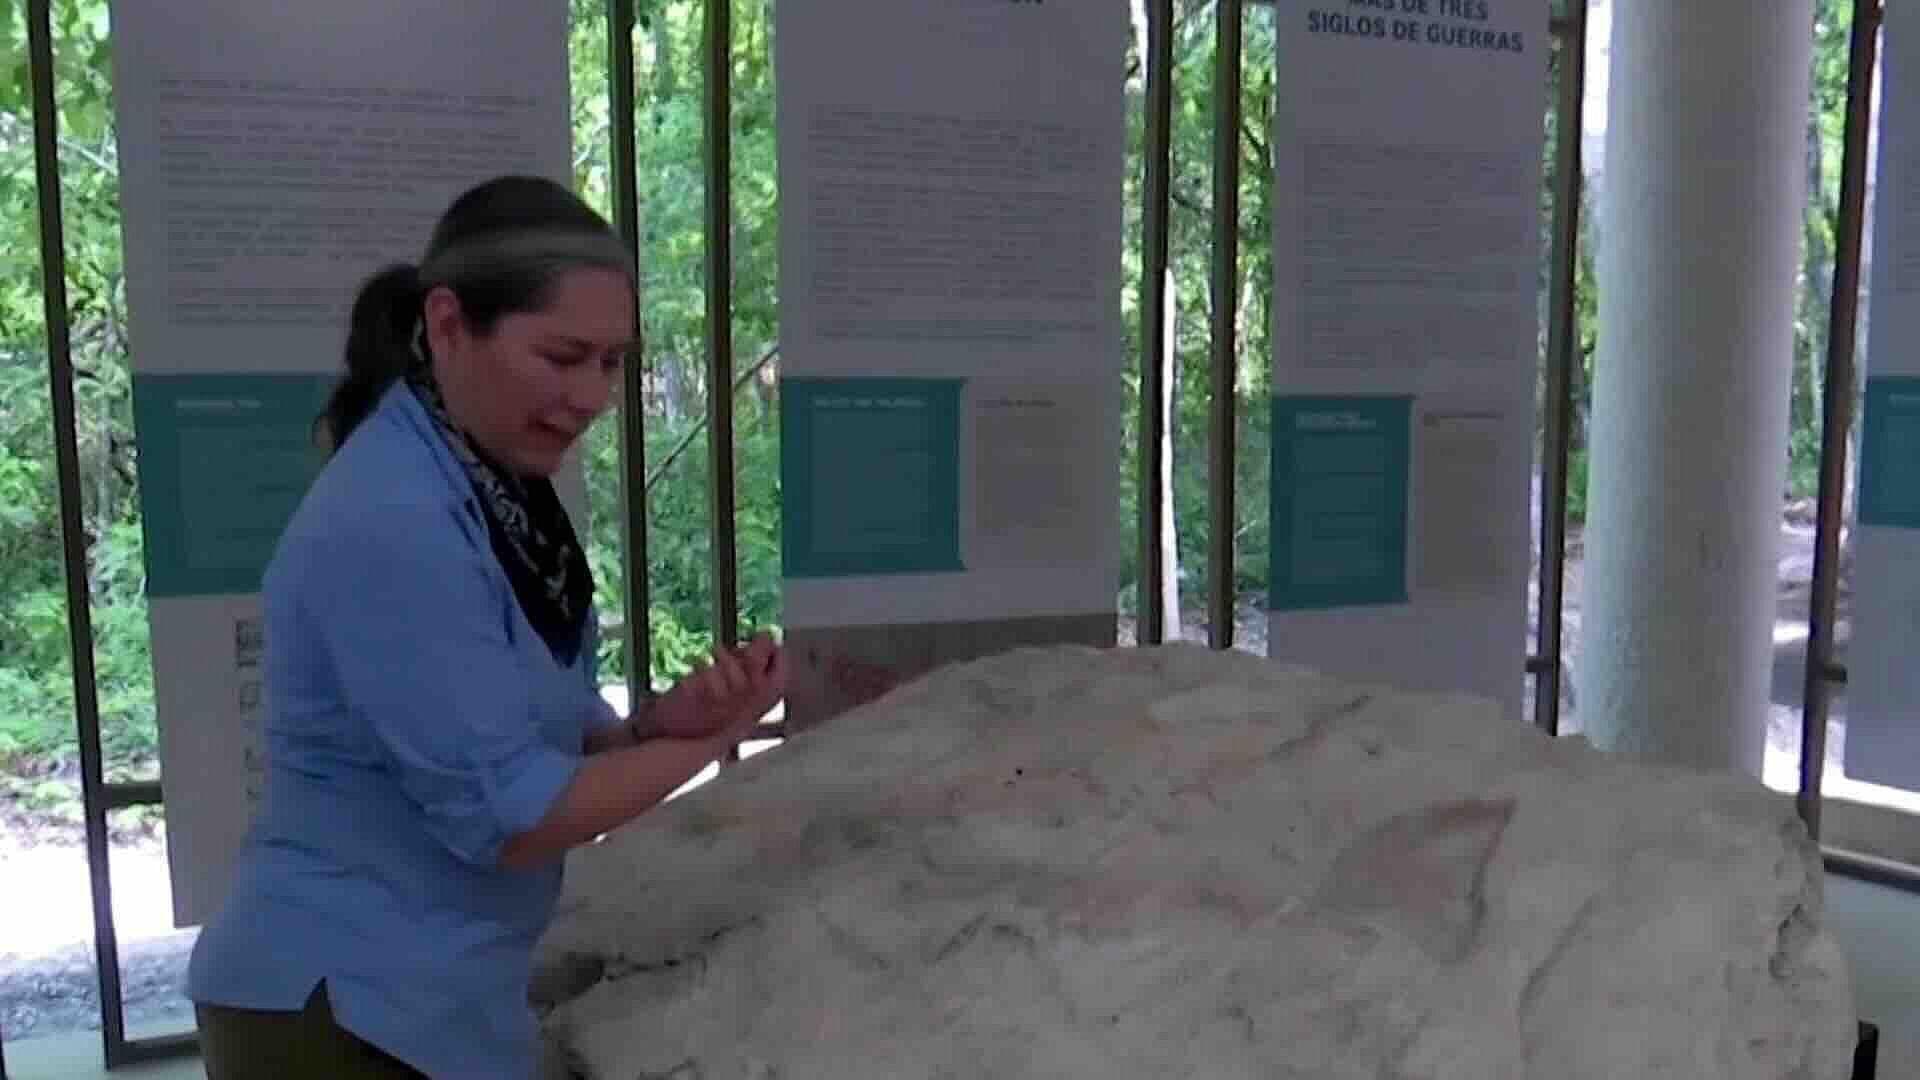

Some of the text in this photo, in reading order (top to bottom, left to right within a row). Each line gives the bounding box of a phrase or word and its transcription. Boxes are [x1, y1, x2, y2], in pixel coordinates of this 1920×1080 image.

[1401, 0, 1429, 14] DE
[1438, 0, 1488, 20] TRES
[1308, 10, 1524, 52] SIGLOS DE GUERRAS
